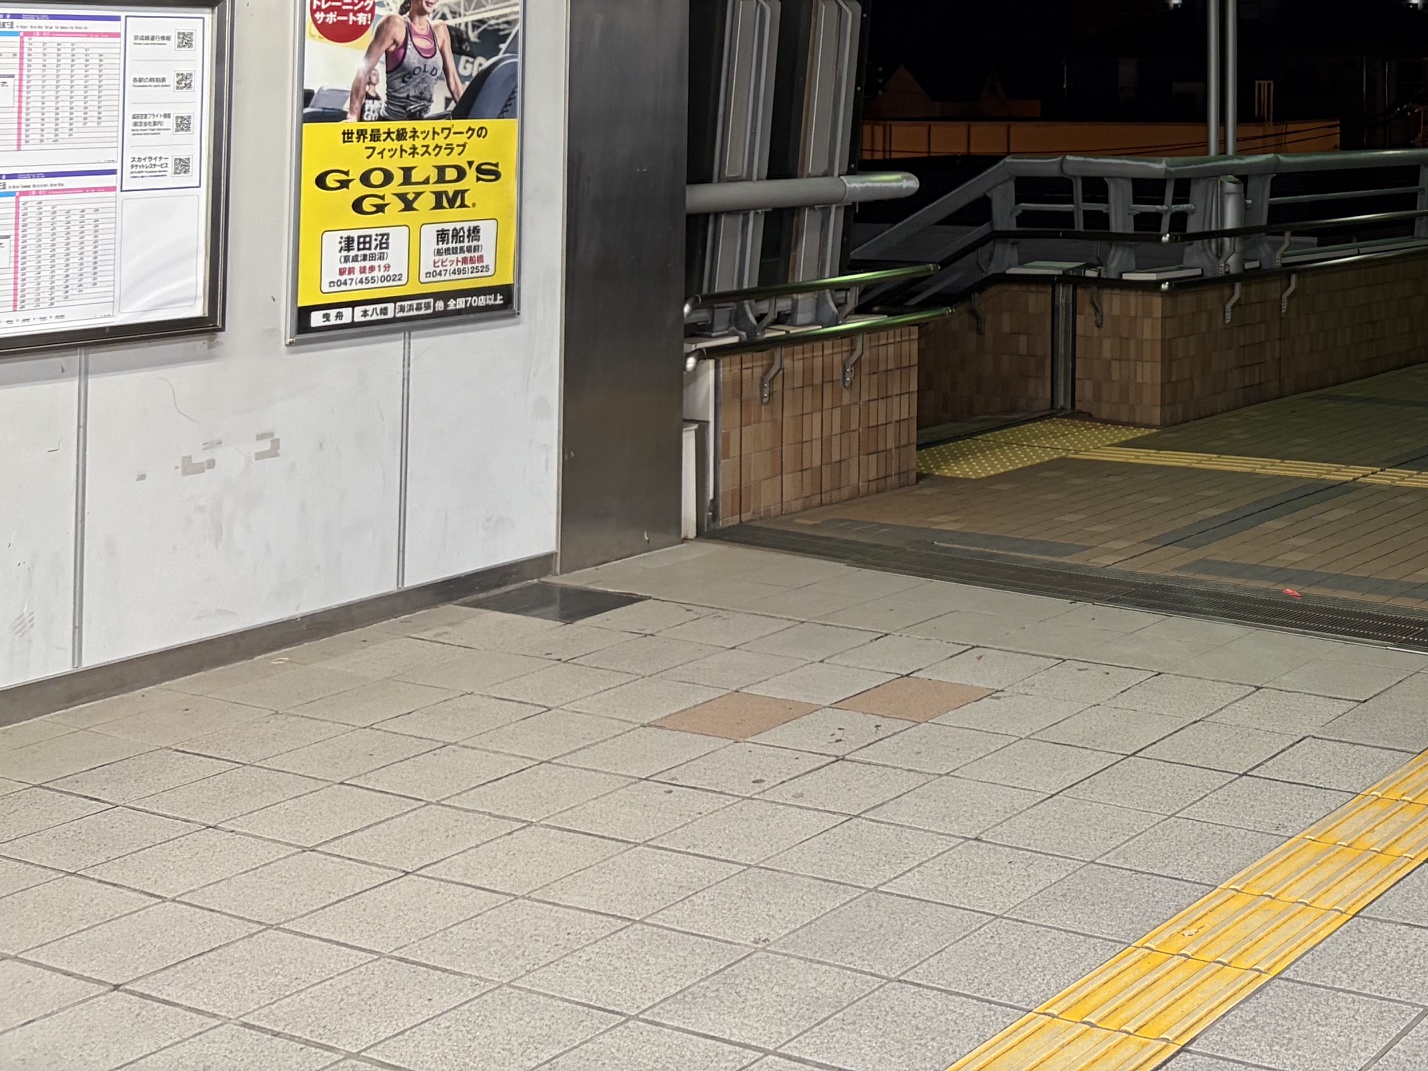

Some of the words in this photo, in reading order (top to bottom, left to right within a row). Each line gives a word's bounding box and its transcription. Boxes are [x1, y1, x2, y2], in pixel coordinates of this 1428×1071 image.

[314, 10, 372, 26] サポート有!
[341, 125, 488, 144] 世界最大級ネットワークの
[364, 142, 468, 160] フィットネスクラブ
[314, 160, 502, 192] GOLD'S
[351, 188, 472, 216] GYM
[338, 232, 391, 253] 津田沼
[435, 224, 482, 246] 南船橋
[339, 251, 389, 264] （京成津田沼）
[338, 266, 356, 277] 駅前
[358, 263, 391, 275] 徒歩1分
[360, 305, 389, 319] 本八幡
[396, 299, 432, 315] 海浜幕張
[435, 299, 445, 312] 他
[446, 293, 504, 311] 全国70店以上
